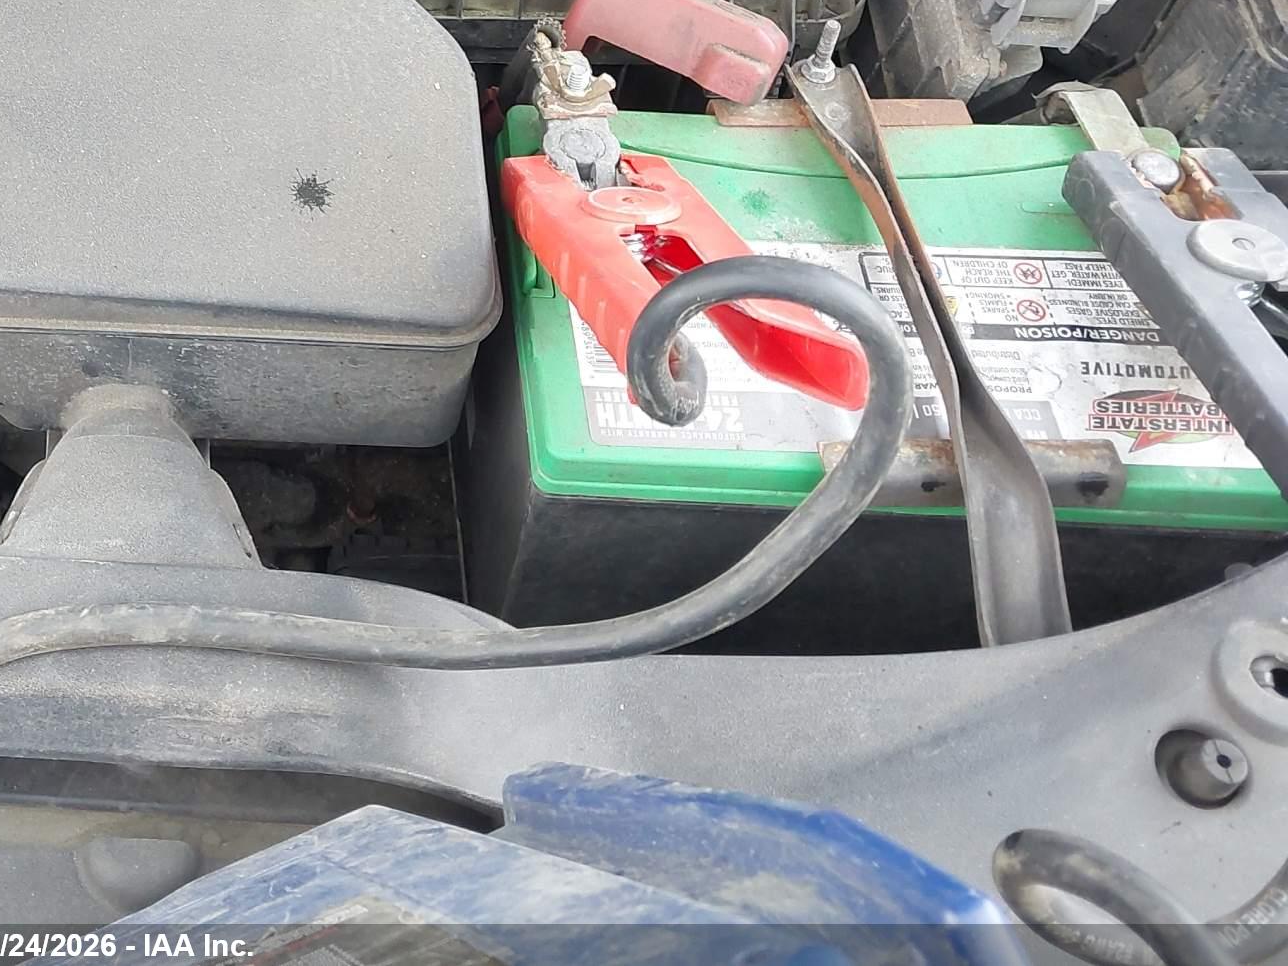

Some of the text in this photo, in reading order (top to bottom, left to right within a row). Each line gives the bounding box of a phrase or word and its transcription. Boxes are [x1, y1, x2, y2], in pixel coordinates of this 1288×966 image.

[1084, 263, 1106, 271] HELP
[1050, 270, 1067, 278] GET
[960, 276, 1013, 285] KEEP OUT OF
[1004, 314, 1018, 322] NO
[1094, 308, 1140, 317] EXPLOSIVE
[1014, 326, 1160, 342] DANGER/POISON
[1080, 361, 1191, 380] UTOMOTIVE
[1095, 401, 1220, 416] BATTERIES
[1012, 408, 1042, 421] CCA
[1092, 416, 1230, 433] INTERSTATE
